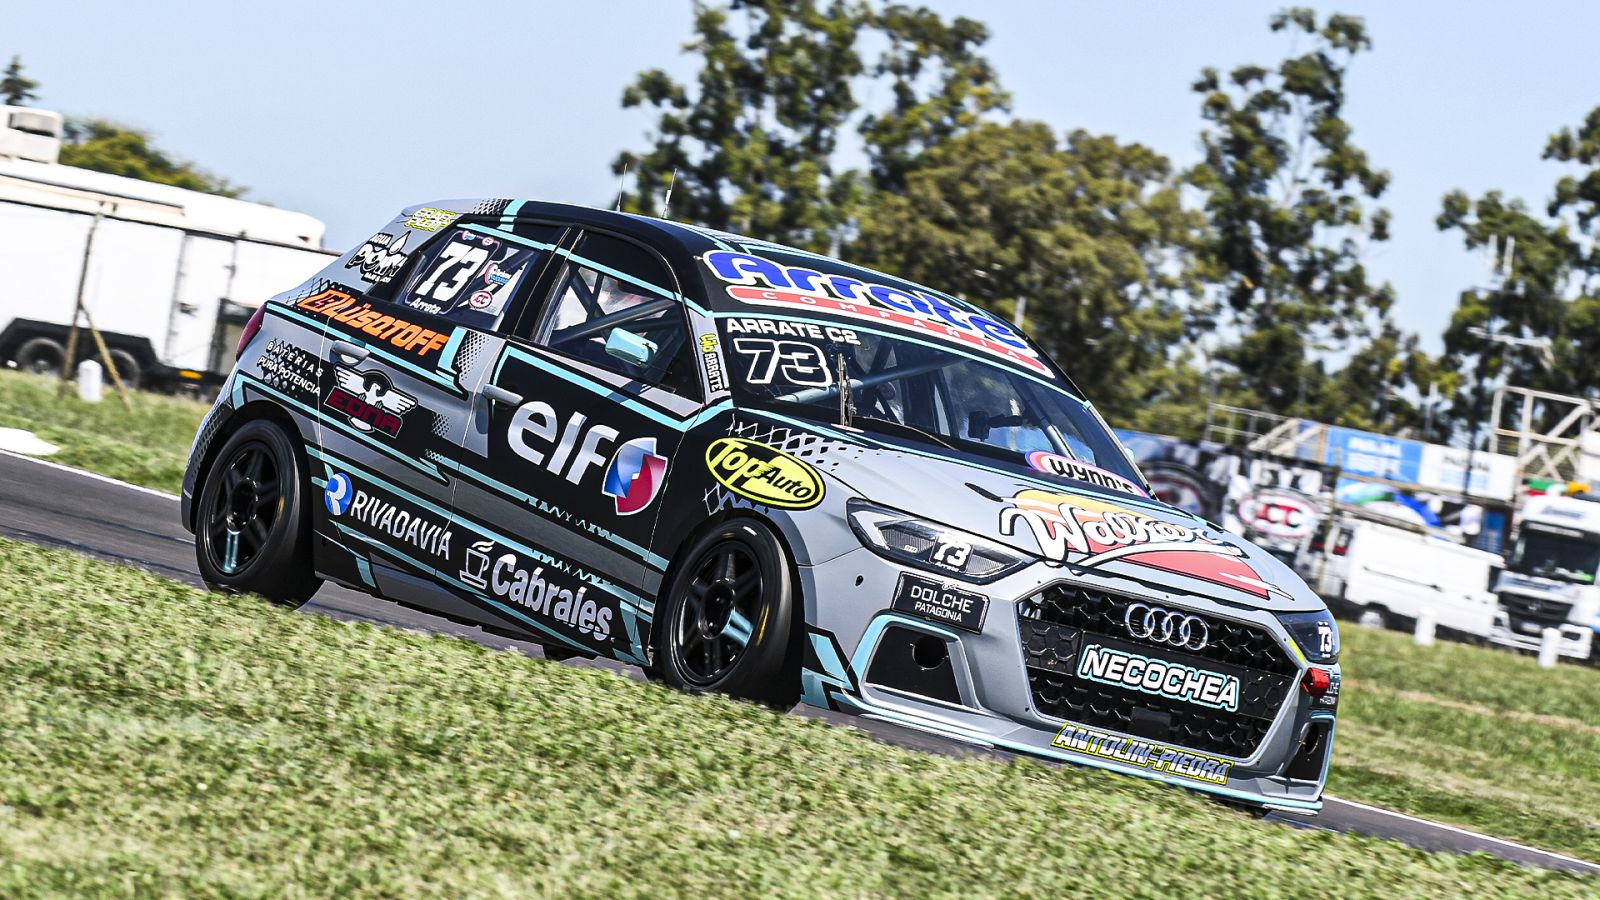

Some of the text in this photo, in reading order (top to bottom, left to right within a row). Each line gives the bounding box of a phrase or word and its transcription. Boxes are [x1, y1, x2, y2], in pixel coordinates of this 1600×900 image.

[415, 241, 489, 302] 73
[409, 297, 437, 315] Arrate
[706, 250, 1033, 353] Arrate
[727, 318, 862, 346] ARRATE C2
[258, 355, 321, 397] PURA POTENCIA
[267, 341, 324, 378] BATERIAS
[705, 352, 724, 392] ARRATE
[733, 338, 833, 387] 73
[508, 401, 619, 485] elf
[350, 489, 453, 561] RIVADAVIA
[933, 541, 972, 567] 73
[492, 553, 613, 641] Cabrales
[910, 586, 974, 614] DOLCHE
[914, 602, 962, 622] PATAGONIA
[1318, 625, 1332, 653] 73
[1081, 648, 1238, 707] NECOCHEA
[1054, 724, 1231, 783] ANTOLIN-PIEDRA
